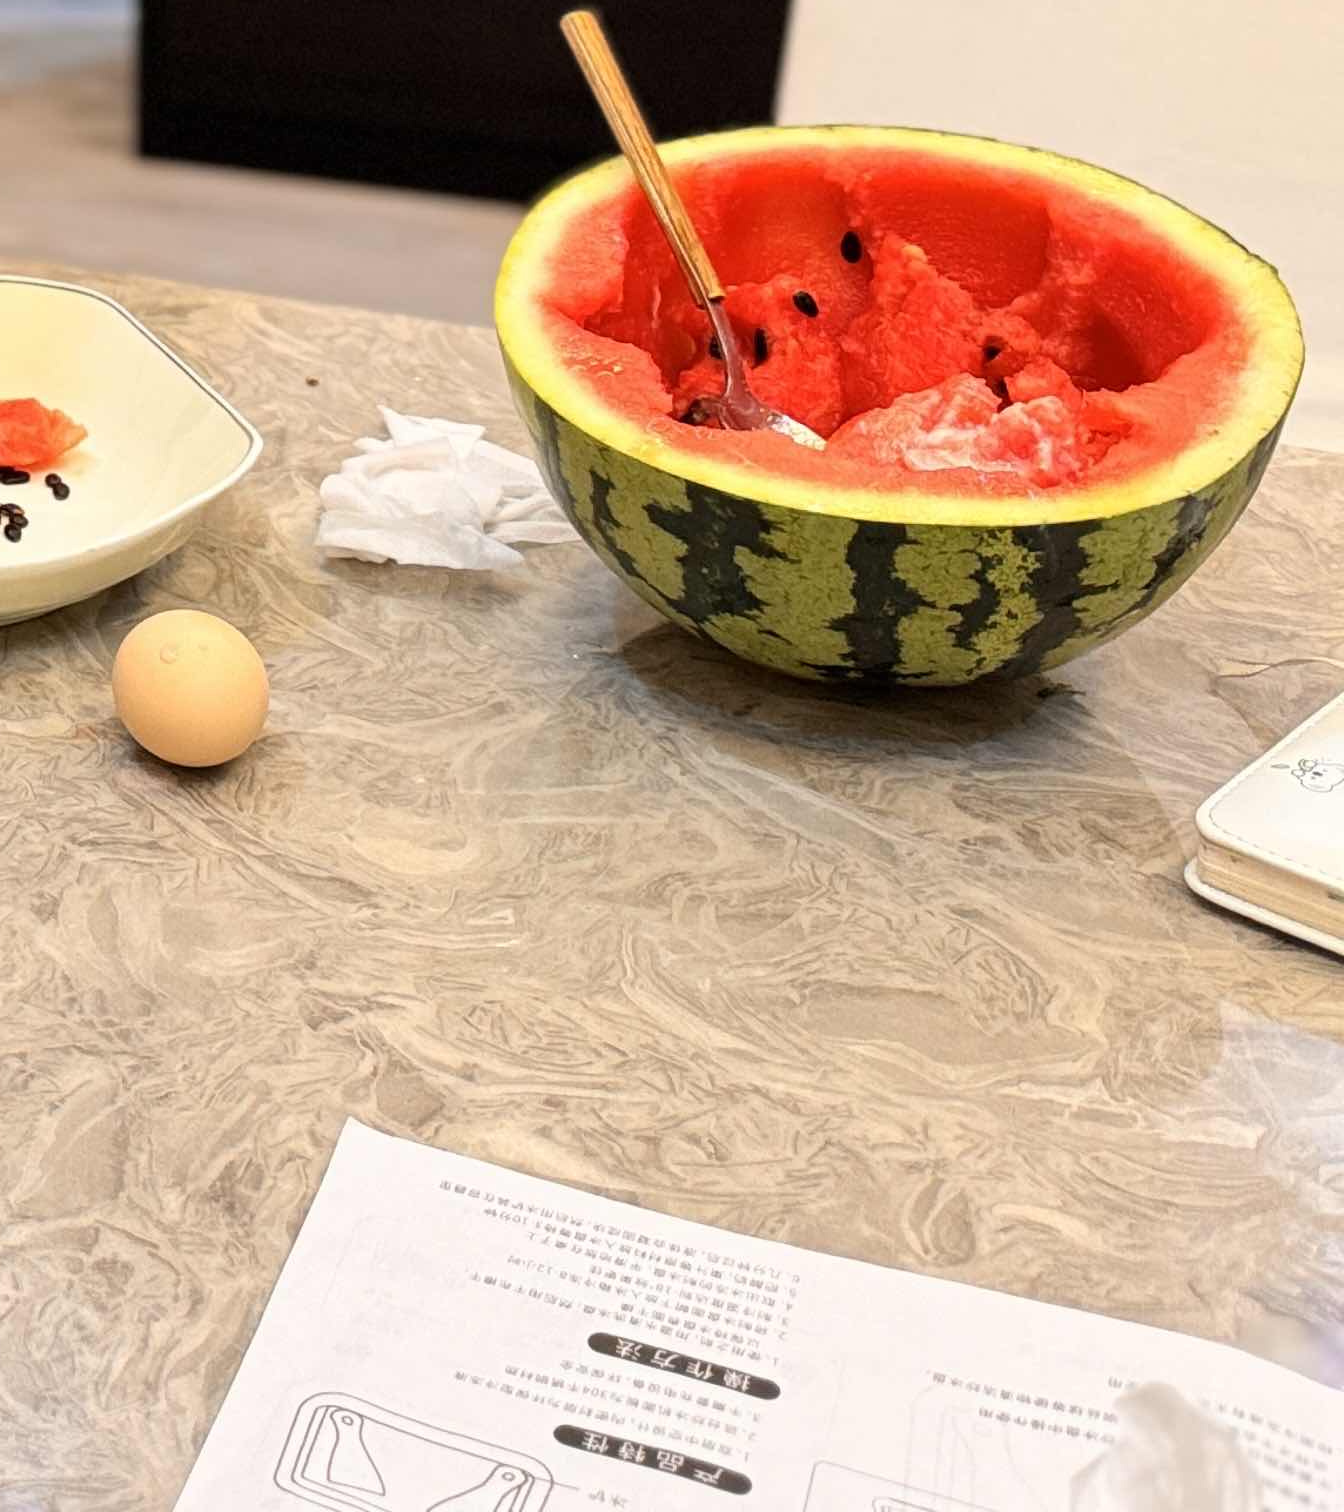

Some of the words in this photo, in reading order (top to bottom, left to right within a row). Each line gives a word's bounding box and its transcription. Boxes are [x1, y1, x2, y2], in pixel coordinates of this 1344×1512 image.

[610, 1335, 753, 1392] 操作方法
[577, 1428, 724, 1487] 产品特性
